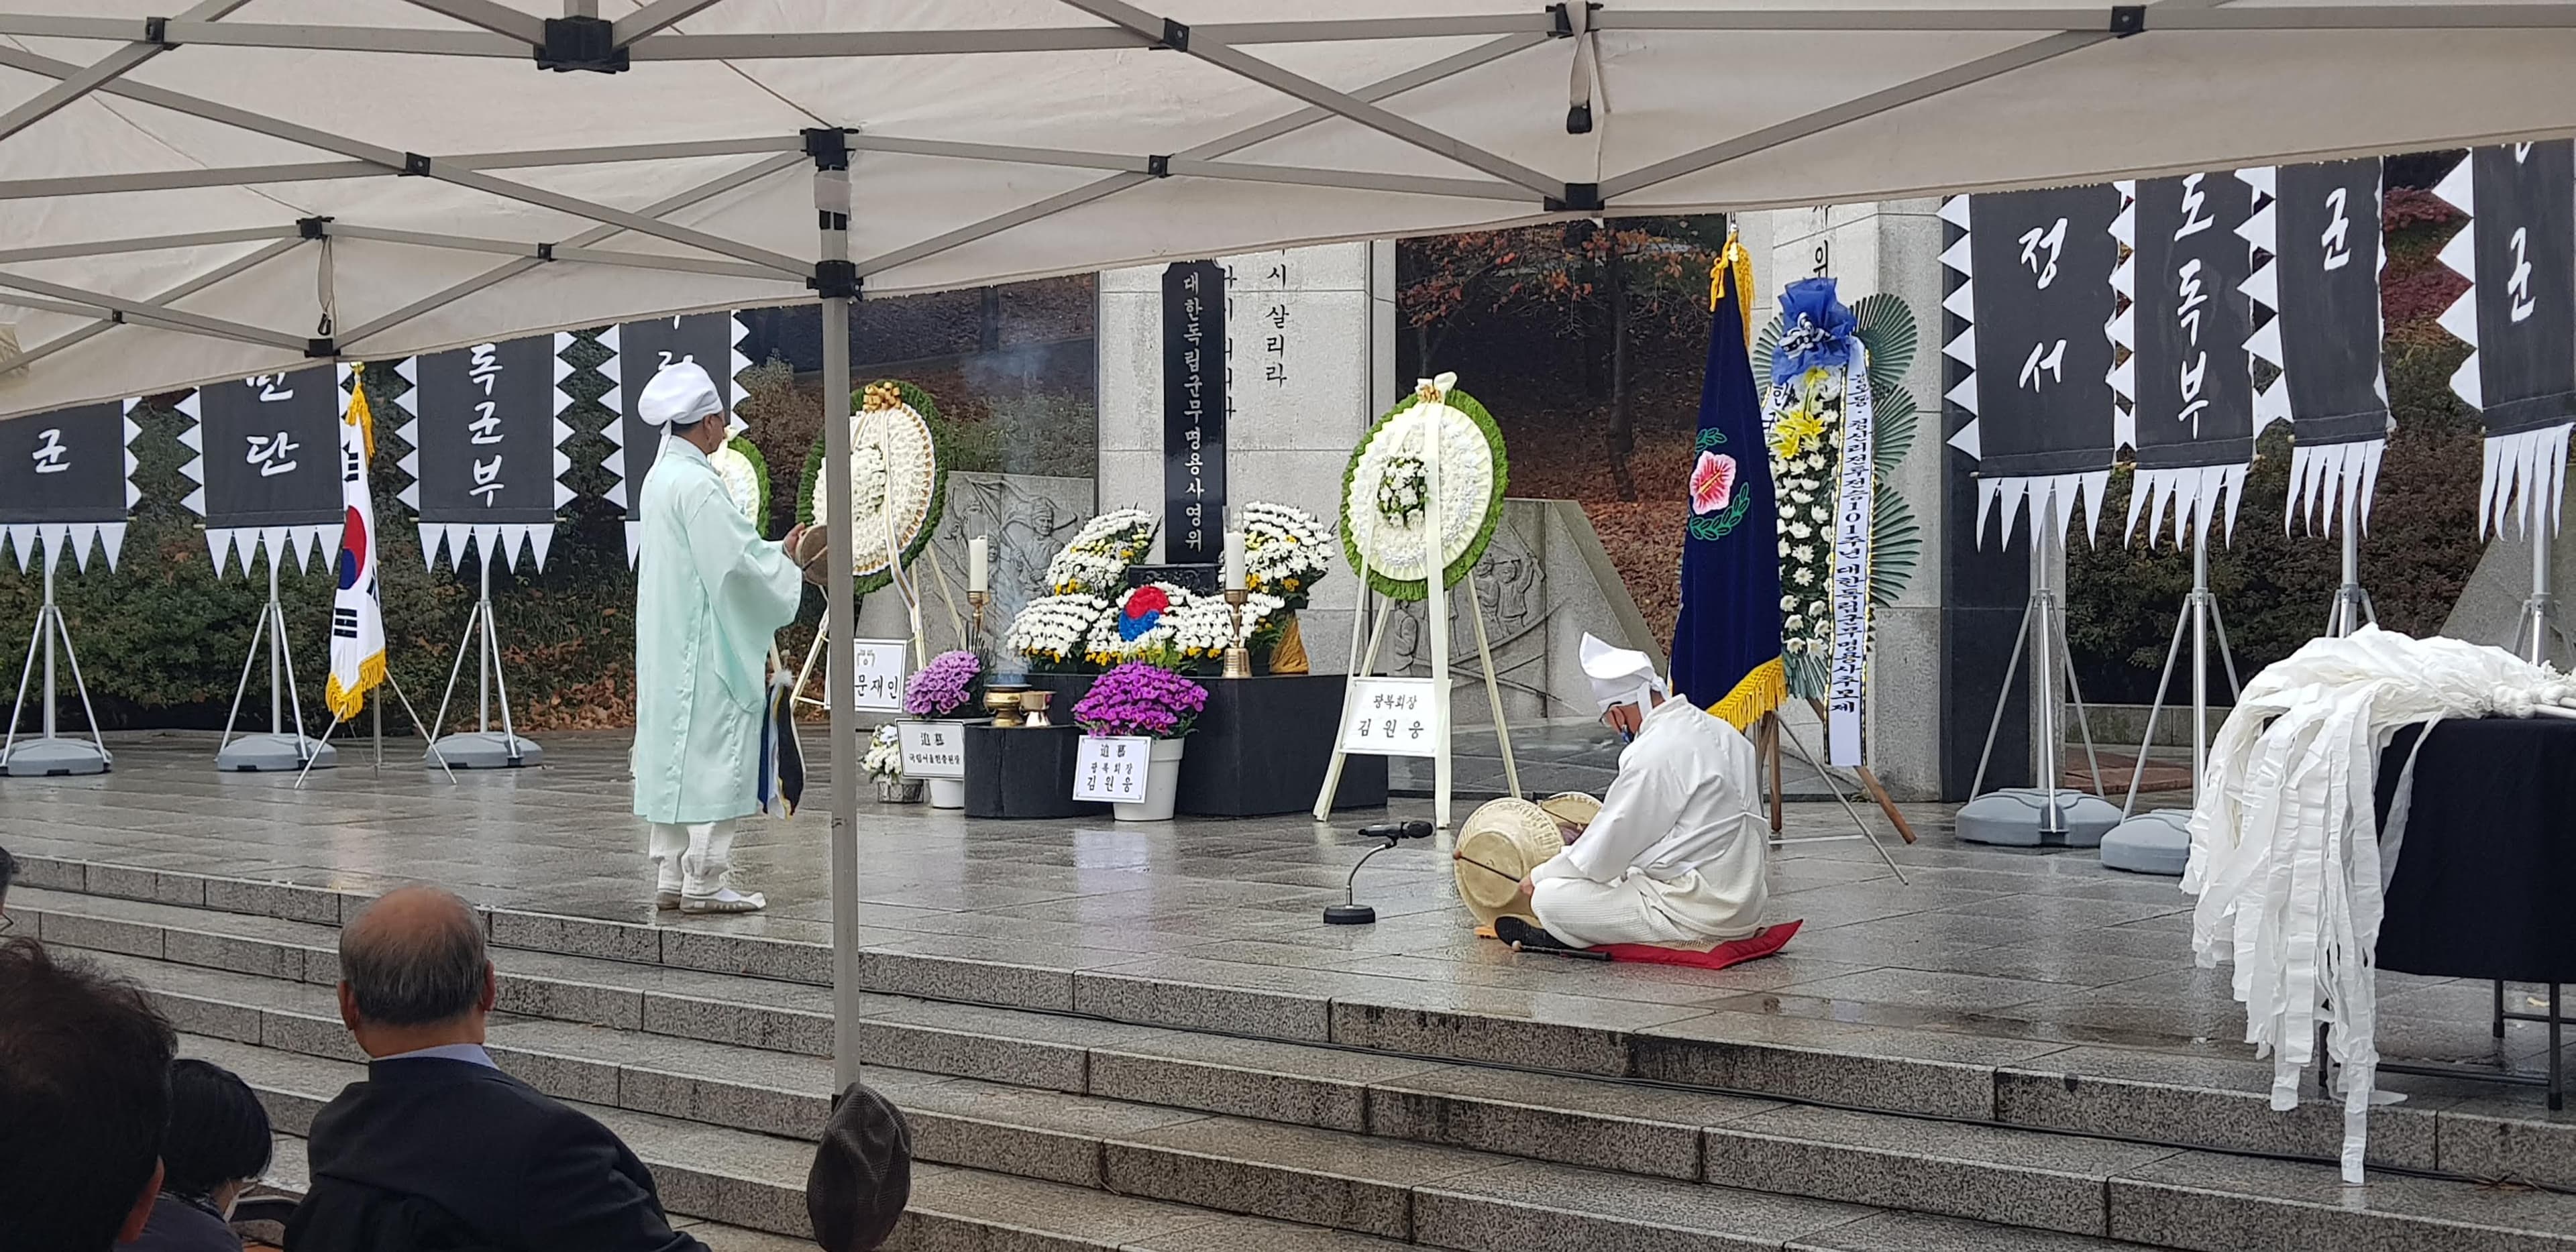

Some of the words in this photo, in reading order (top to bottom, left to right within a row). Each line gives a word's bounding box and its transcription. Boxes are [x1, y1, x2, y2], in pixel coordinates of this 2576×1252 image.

[2321, 187, 2351, 270] 군
[2174, 172, 2215, 439] 도독부
[1265, 304, 1290, 388] 살리라
[32, 429, 70, 473] 군
[854, 674, 898, 699] 문재인
[1374, 693, 1417, 710] 광복회장
[1358, 718, 1424, 740] 김원웅
[1087, 775, 1133, 793] 김원웅
